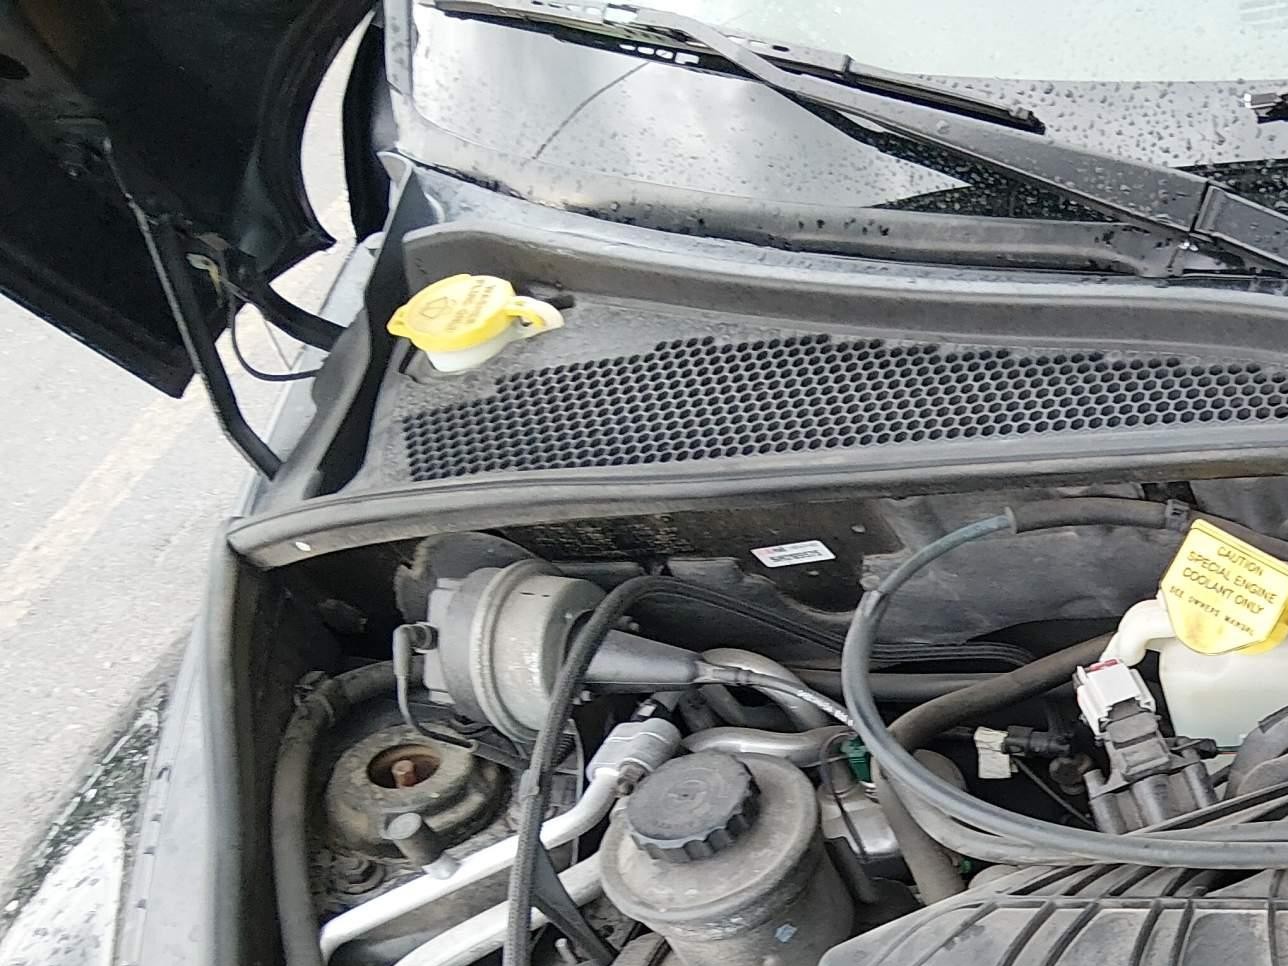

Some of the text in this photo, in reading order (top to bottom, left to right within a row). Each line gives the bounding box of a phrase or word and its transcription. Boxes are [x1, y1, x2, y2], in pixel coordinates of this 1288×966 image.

[1187, 551, 1277, 605] SPECIAL ENGINE
[1216, 546, 1264, 577] CAUTION
[1182, 567, 1264, 614] COOLANT ONLY
